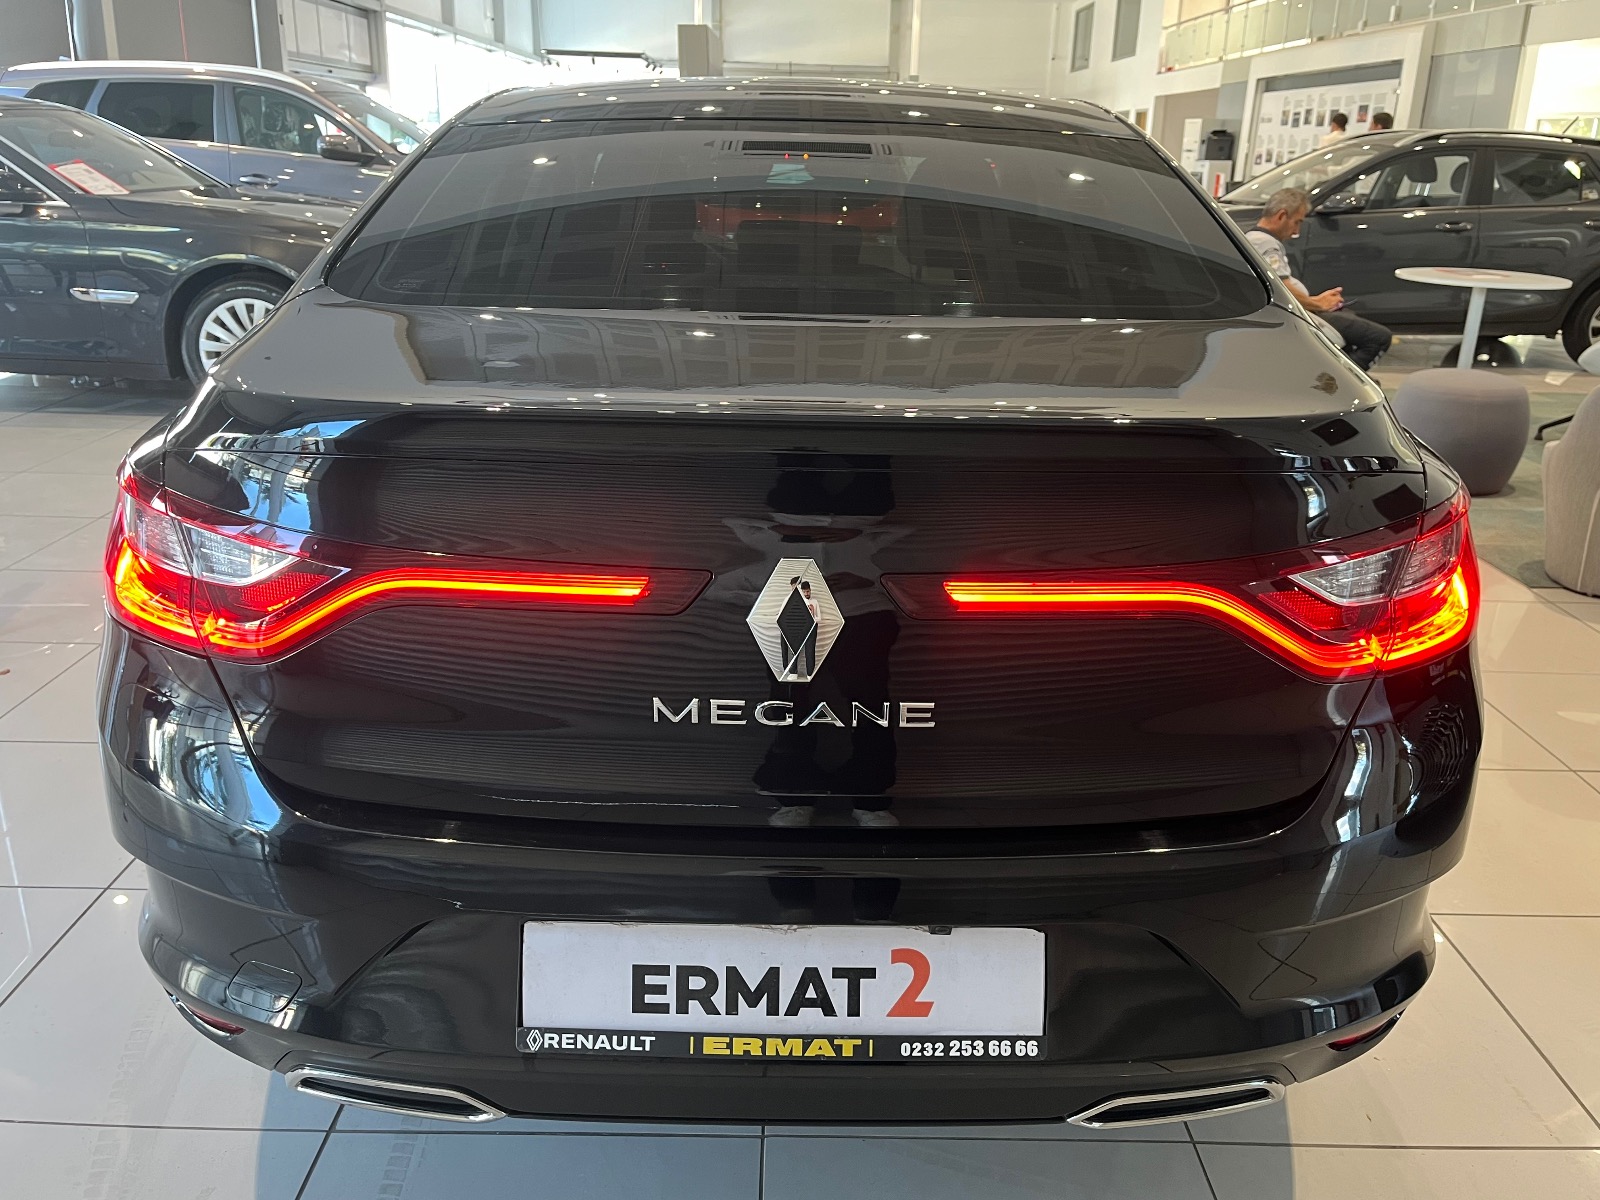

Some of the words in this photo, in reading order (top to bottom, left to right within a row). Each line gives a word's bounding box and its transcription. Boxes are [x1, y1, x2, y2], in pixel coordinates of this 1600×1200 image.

[651, 697, 936, 728] MEGANE
[631, 964, 877, 1018] ERMAT
[886, 947, 935, 1018] 2
[543, 1033, 656, 1051] RENAULT
[702, 1036, 862, 1057] ERMAT
[900, 1042, 945, 1057] 0232
[949, 1040, 984, 1057] 253
[988, 1040, 1011, 1057] 66
[1015, 1040, 1039, 1057] 66
